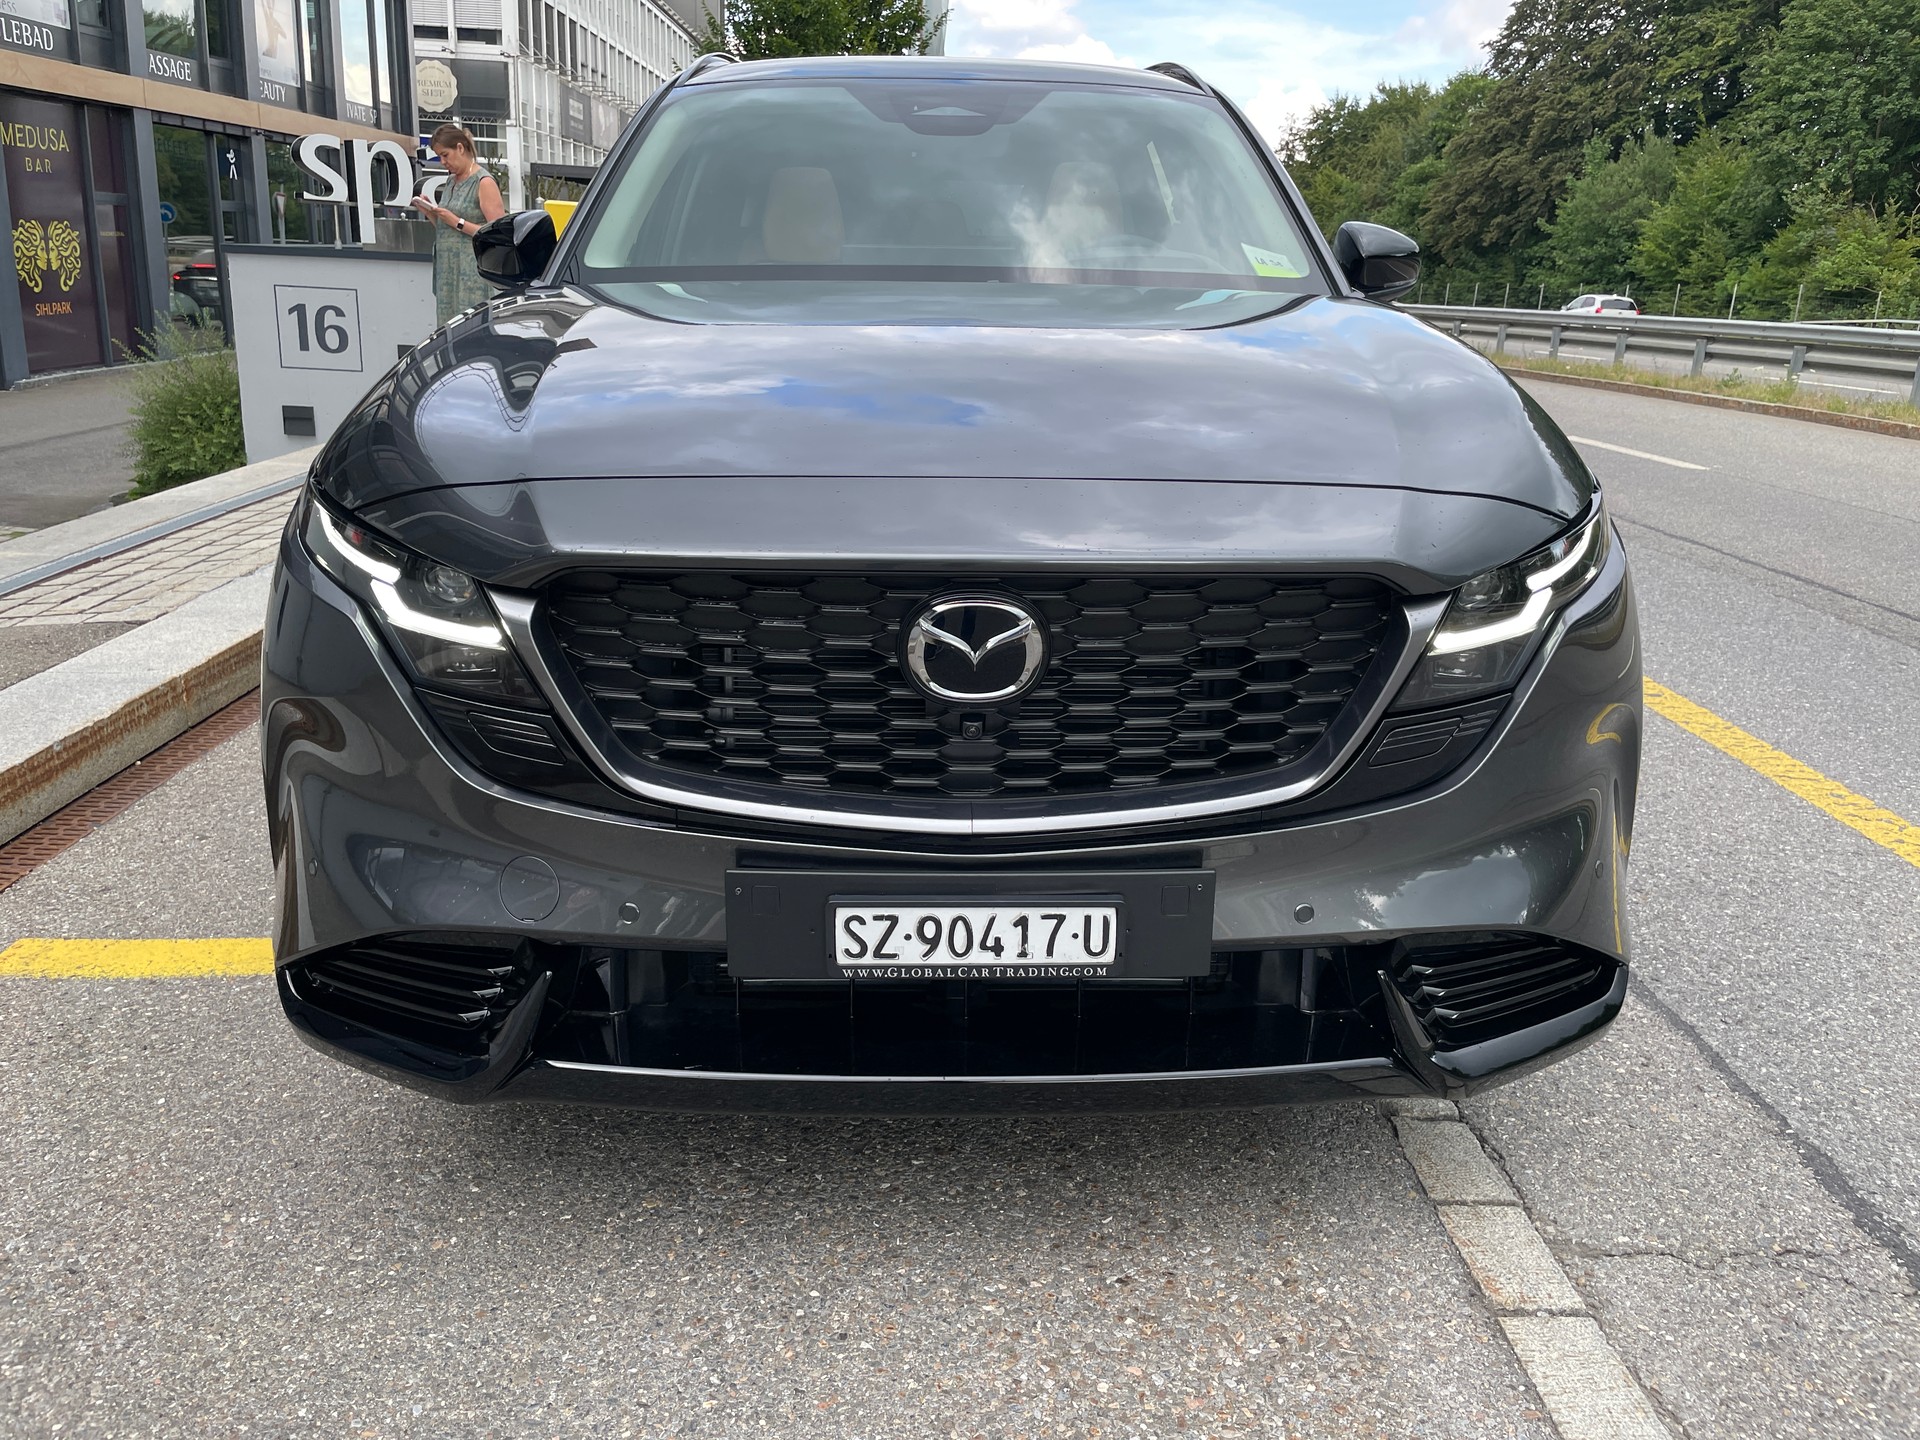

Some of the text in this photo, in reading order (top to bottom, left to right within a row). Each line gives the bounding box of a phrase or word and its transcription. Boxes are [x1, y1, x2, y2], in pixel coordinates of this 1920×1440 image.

[0, 17, 54, 51] LEBAD
[416, 79, 452, 89] REMIUM
[0, 121, 70, 153] MEDUSA
[25, 156, 53, 174] BAR
[35, 301, 73, 317] SIHLPARK
[287, 302, 350, 355] 16
